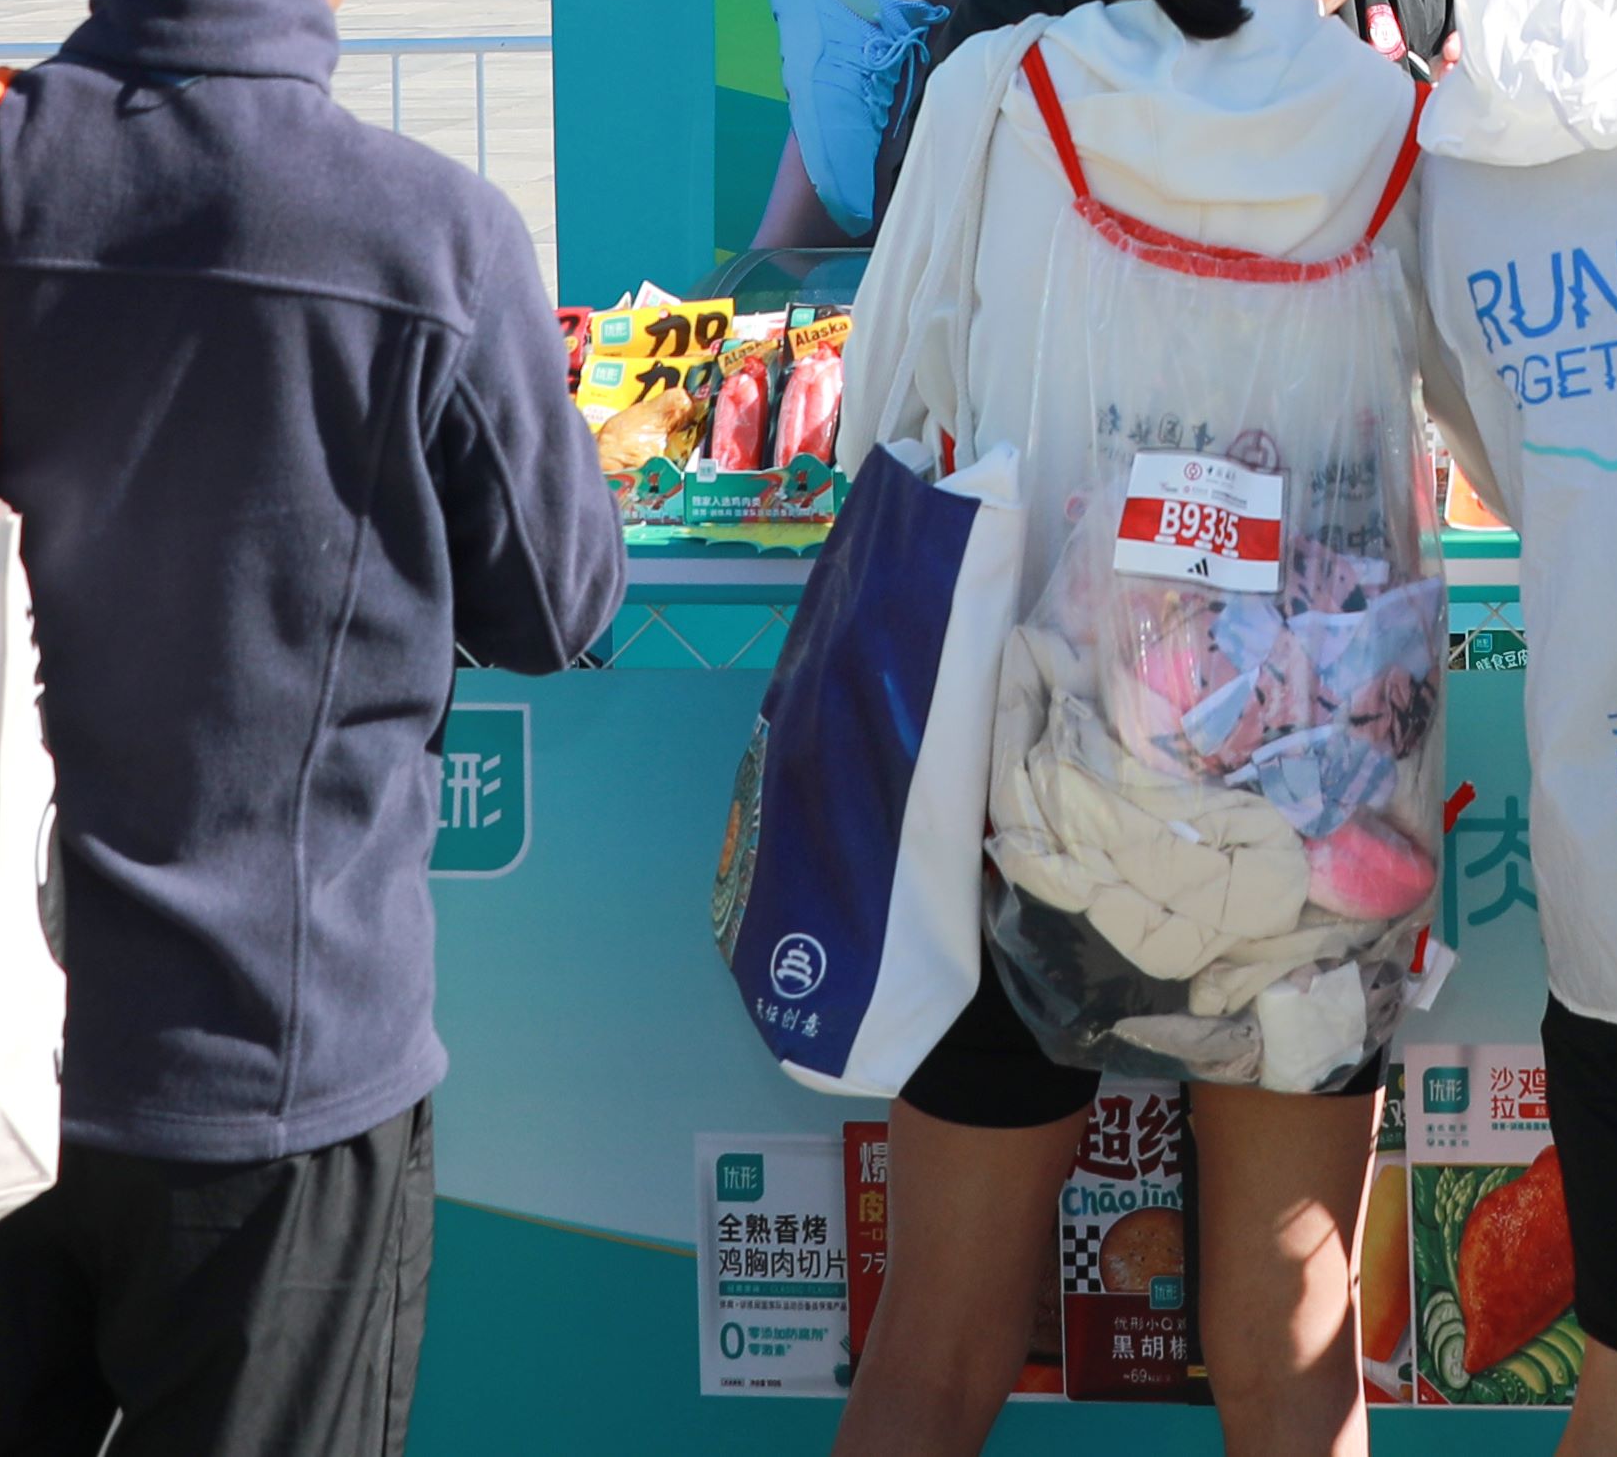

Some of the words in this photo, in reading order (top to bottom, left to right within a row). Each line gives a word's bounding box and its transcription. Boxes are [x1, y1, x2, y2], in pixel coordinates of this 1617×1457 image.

[795, 321, 849, 348] Alaska
[1160, 500, 1239, 548] B9335
[1429, 1079, 1462, 1102] 优形
[724, 1166, 757, 1189] 优形
[718, 1213, 828, 1245] 全熟香烤
[719, 1248, 847, 1279] 鸡胸肉切片
[720, 1321, 745, 1360] 0
